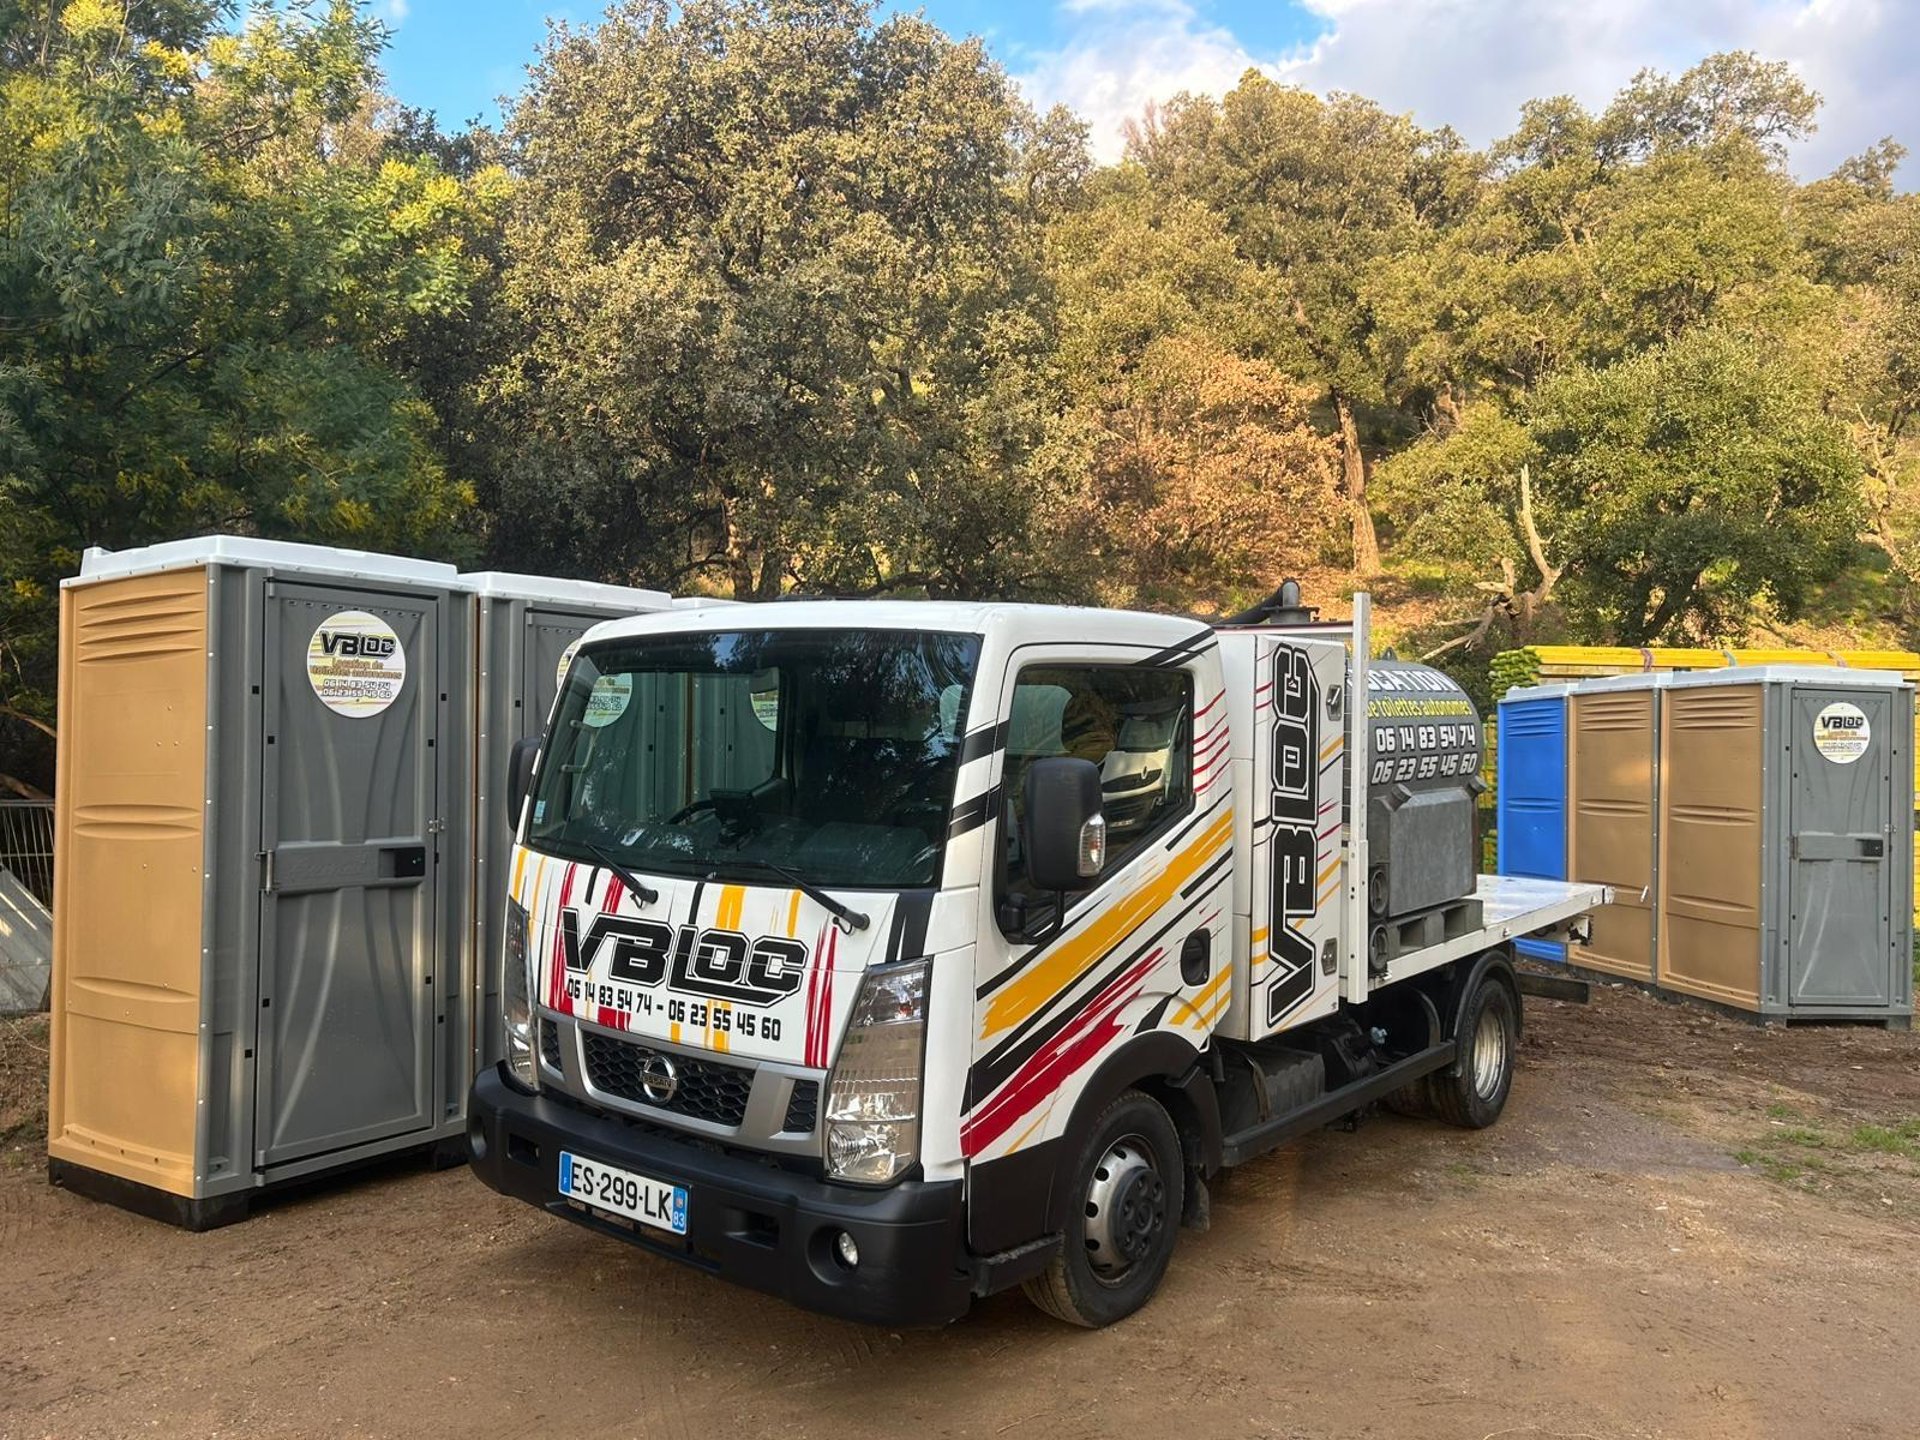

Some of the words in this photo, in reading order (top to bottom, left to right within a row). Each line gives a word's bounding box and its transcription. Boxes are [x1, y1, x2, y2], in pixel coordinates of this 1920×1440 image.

[1347, 669, 1459, 691] OCATION
[1375, 696, 1422, 717] toilettes
[1420, 697, 1472, 716] autonomes
[1375, 726, 1395, 752] 06
[1399, 725, 1415, 751] 14
[1417, 724, 1436, 750] 83
[1439, 724, 1457, 748] 54
[1459, 723, 1477, 747] 74
[1372, 759, 1394, 784] 06
[1395, 757, 1416, 782] 23
[1417, 755, 1438, 780] 55
[1439, 753, 1459, 777] 45
[1459, 752, 1478, 775] 60
[567, 978, 581, 999] 06
[585, 981, 596, 1003] 14
[599, 985, 614, 1007] 83
[616, 988, 632, 1011] 54
[636, 992, 652, 1016] 74
[669, 999, 685, 1022] 06
[690, 1003, 708, 1027] 23
[713, 1007, 732, 1032] 55
[736, 1011, 756, 1037] 45
[761, 1016, 781, 1042] 60
[673, 1211, 685, 1227] 83
